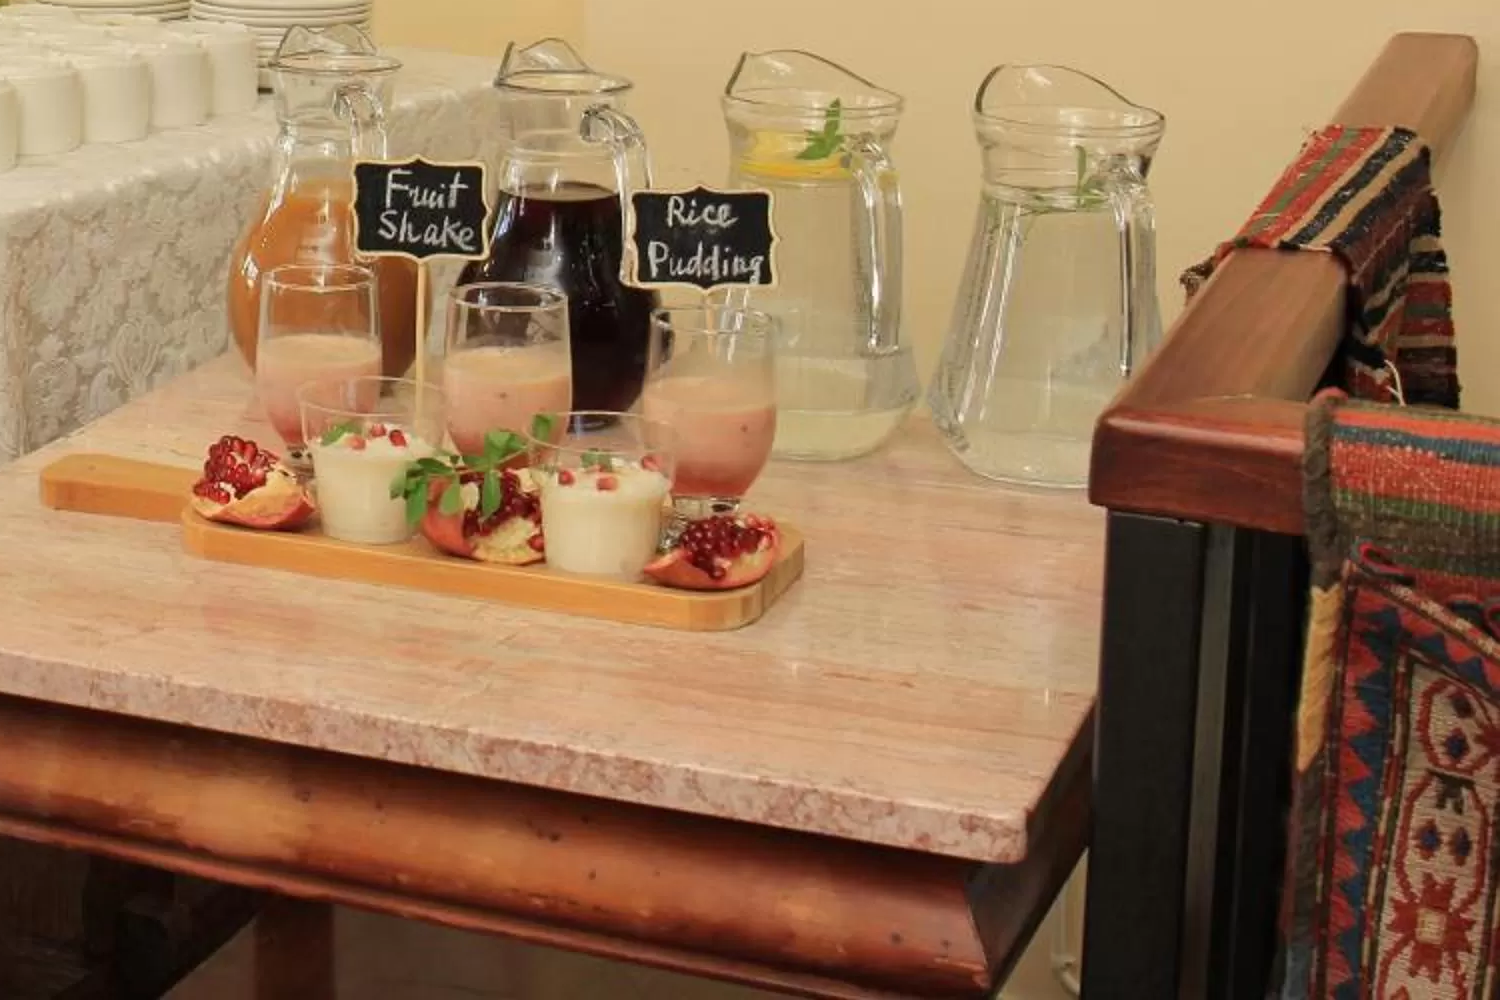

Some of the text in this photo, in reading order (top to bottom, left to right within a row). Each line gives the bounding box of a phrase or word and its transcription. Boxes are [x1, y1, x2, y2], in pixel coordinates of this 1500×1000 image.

[386, 168, 469, 209] Fruit
[378, 209, 477, 251] Shake
[666, 195, 740, 228] Rice
[647, 240, 765, 284] Pudding
